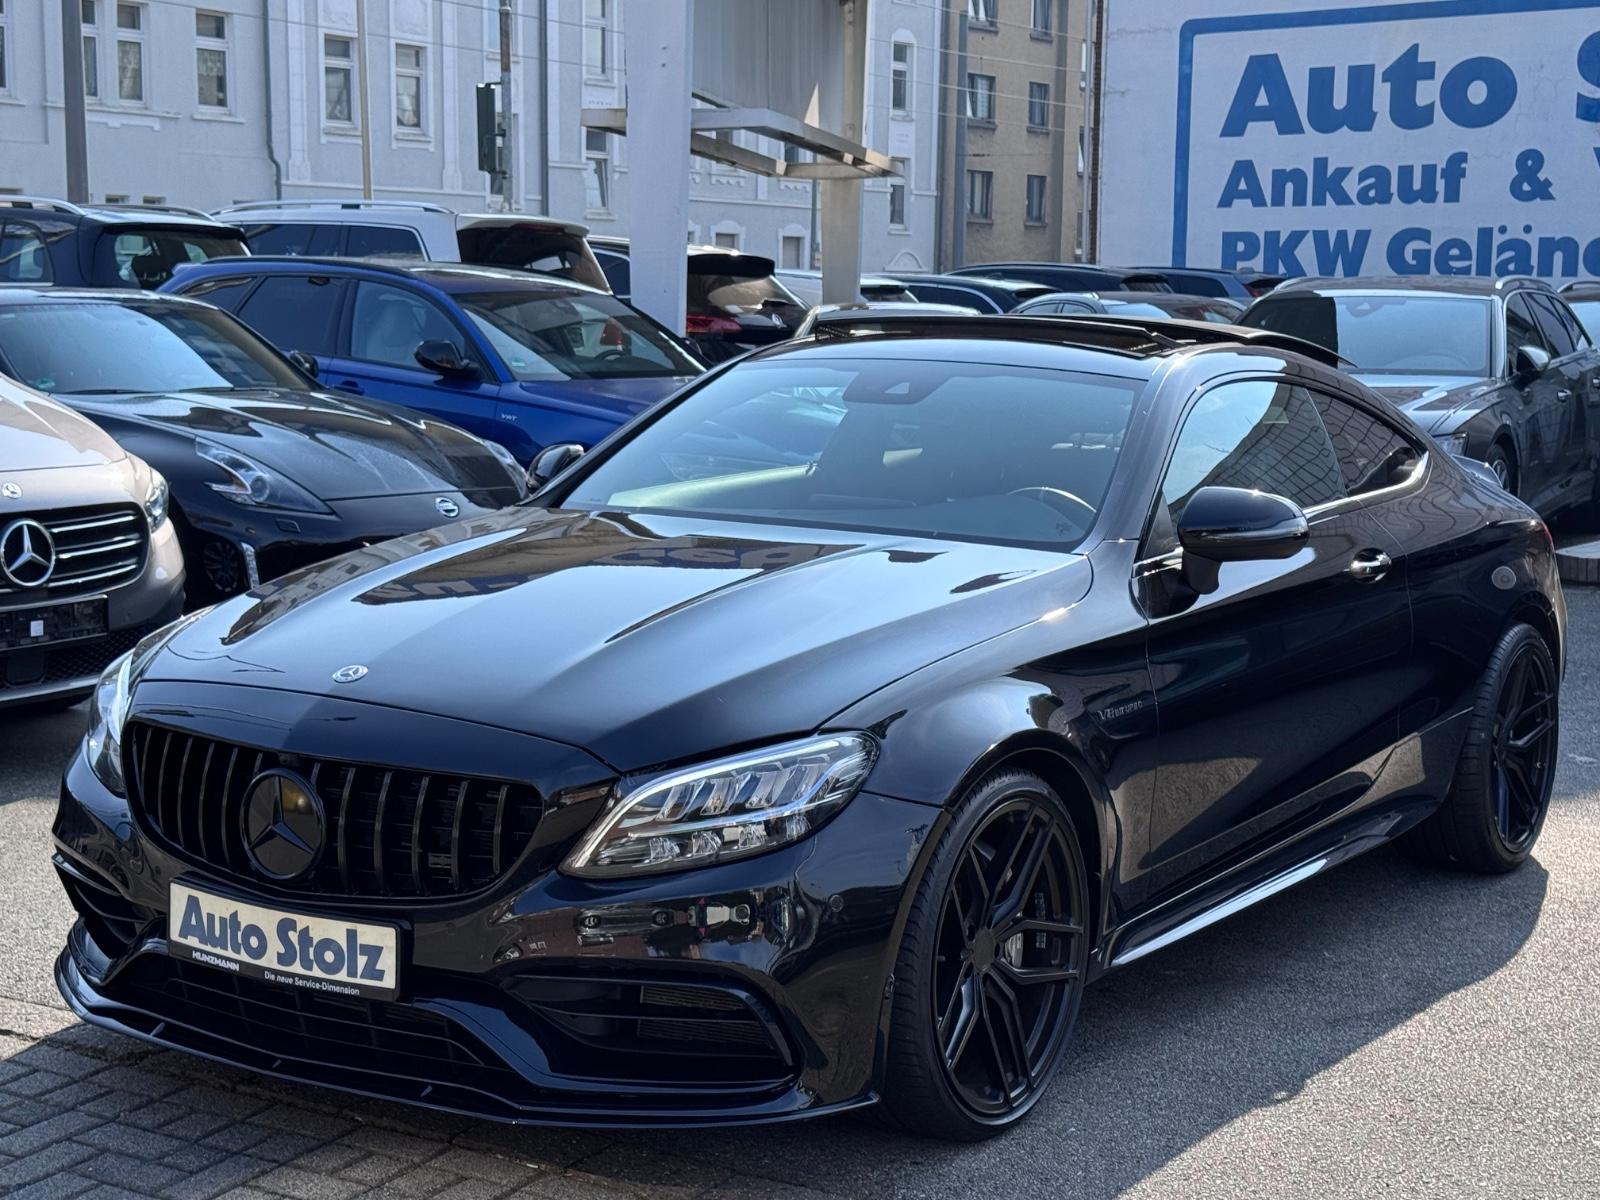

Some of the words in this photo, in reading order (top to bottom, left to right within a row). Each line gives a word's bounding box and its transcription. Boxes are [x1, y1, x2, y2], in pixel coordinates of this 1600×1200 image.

[1219, 43, 1517, 138] Auto
[1217, 152, 1468, 208] Ankauf
[1509, 148, 1556, 201] &
[1221, 229, 1371, 277] PKW
[178, 894, 268, 960] Auto
[276, 917, 386, 981] Stolz
[264, 970, 276, 981] Die
[276, 974, 293, 985] neue
[294, 976, 360, 996] Service-Dimension
